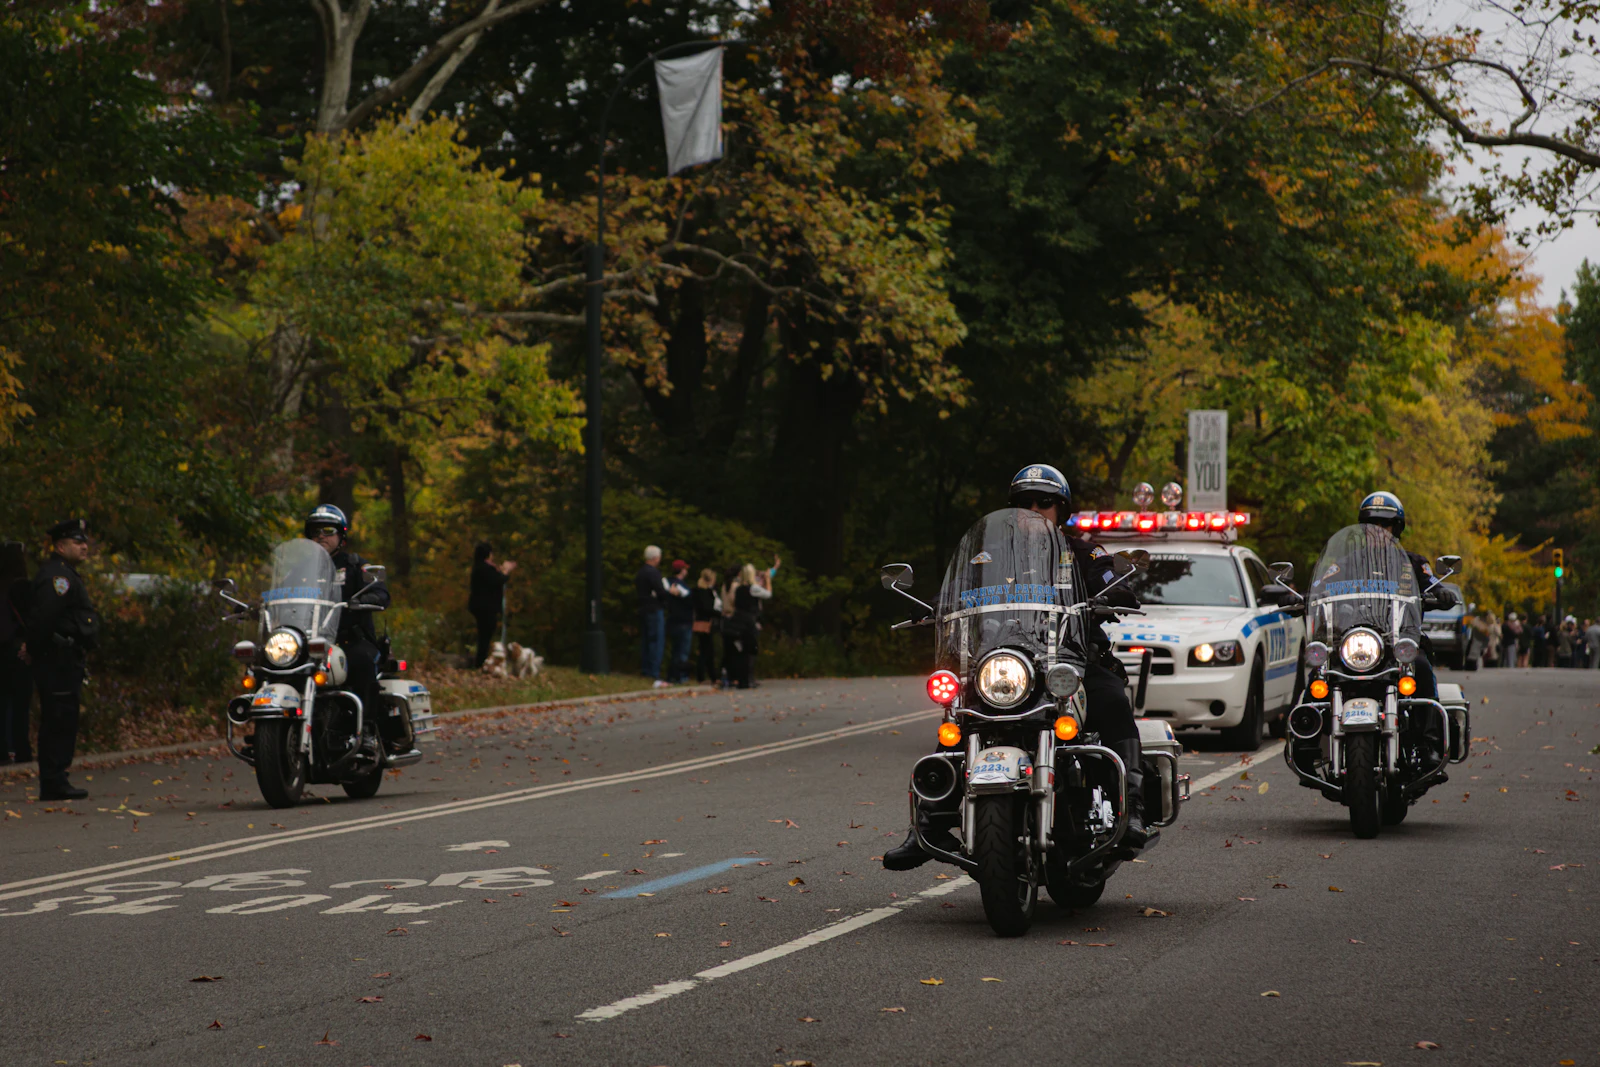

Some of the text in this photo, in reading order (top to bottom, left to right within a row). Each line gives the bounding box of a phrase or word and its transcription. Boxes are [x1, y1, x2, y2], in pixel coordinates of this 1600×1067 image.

[1194, 461, 1221, 492] YOU
[961, 583, 1059, 600] HIGHWAY PATROL
[966, 594, 1054, 608] NYPD POLICE
